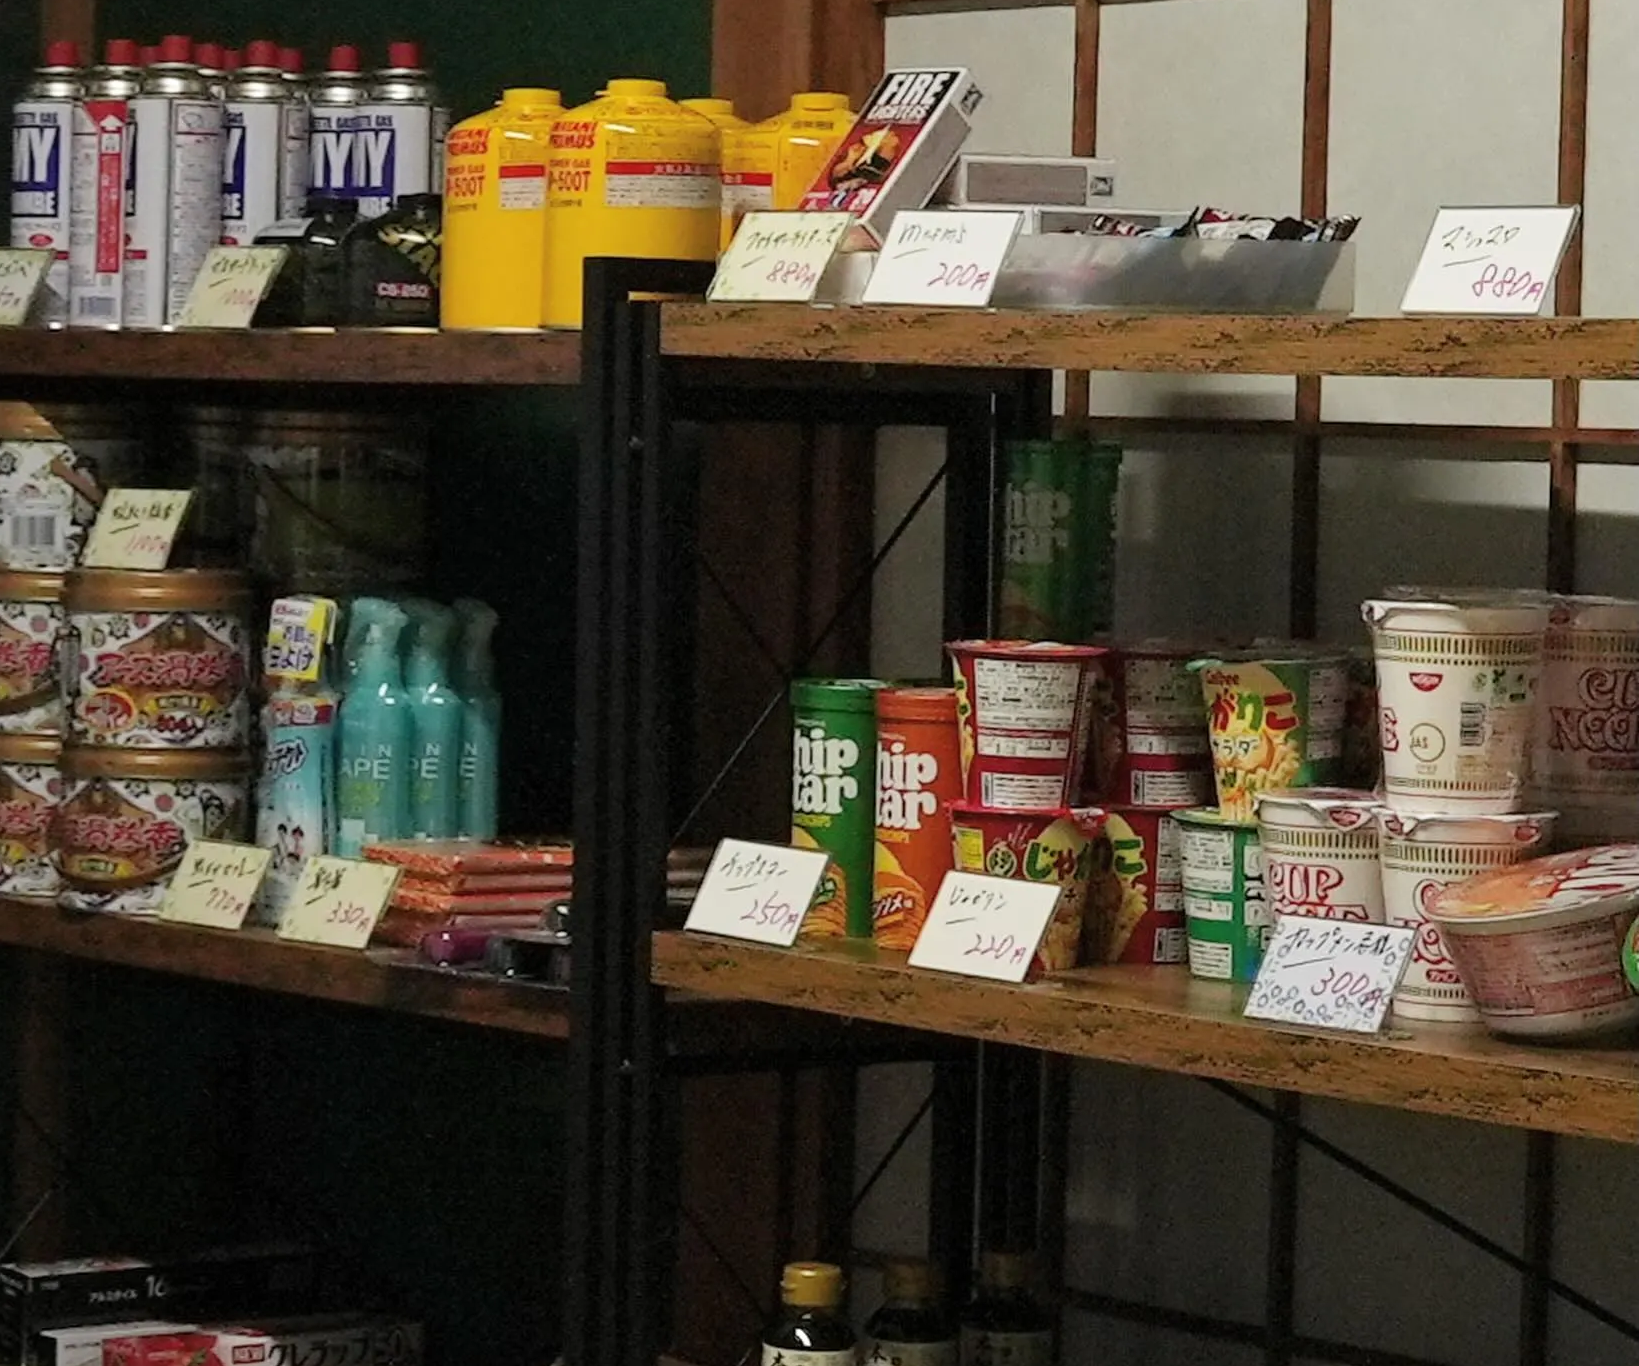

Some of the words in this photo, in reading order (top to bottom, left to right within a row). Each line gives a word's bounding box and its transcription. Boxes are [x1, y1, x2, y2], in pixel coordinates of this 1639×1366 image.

[866, 71, 950, 105] FIRE
[1210, 687, 1299, 733] がりこ
[794, 726, 860, 776] hip
[877, 740, 939, 791] hip
[793, 774, 858, 815] tar
[876, 787, 938, 831] tar
